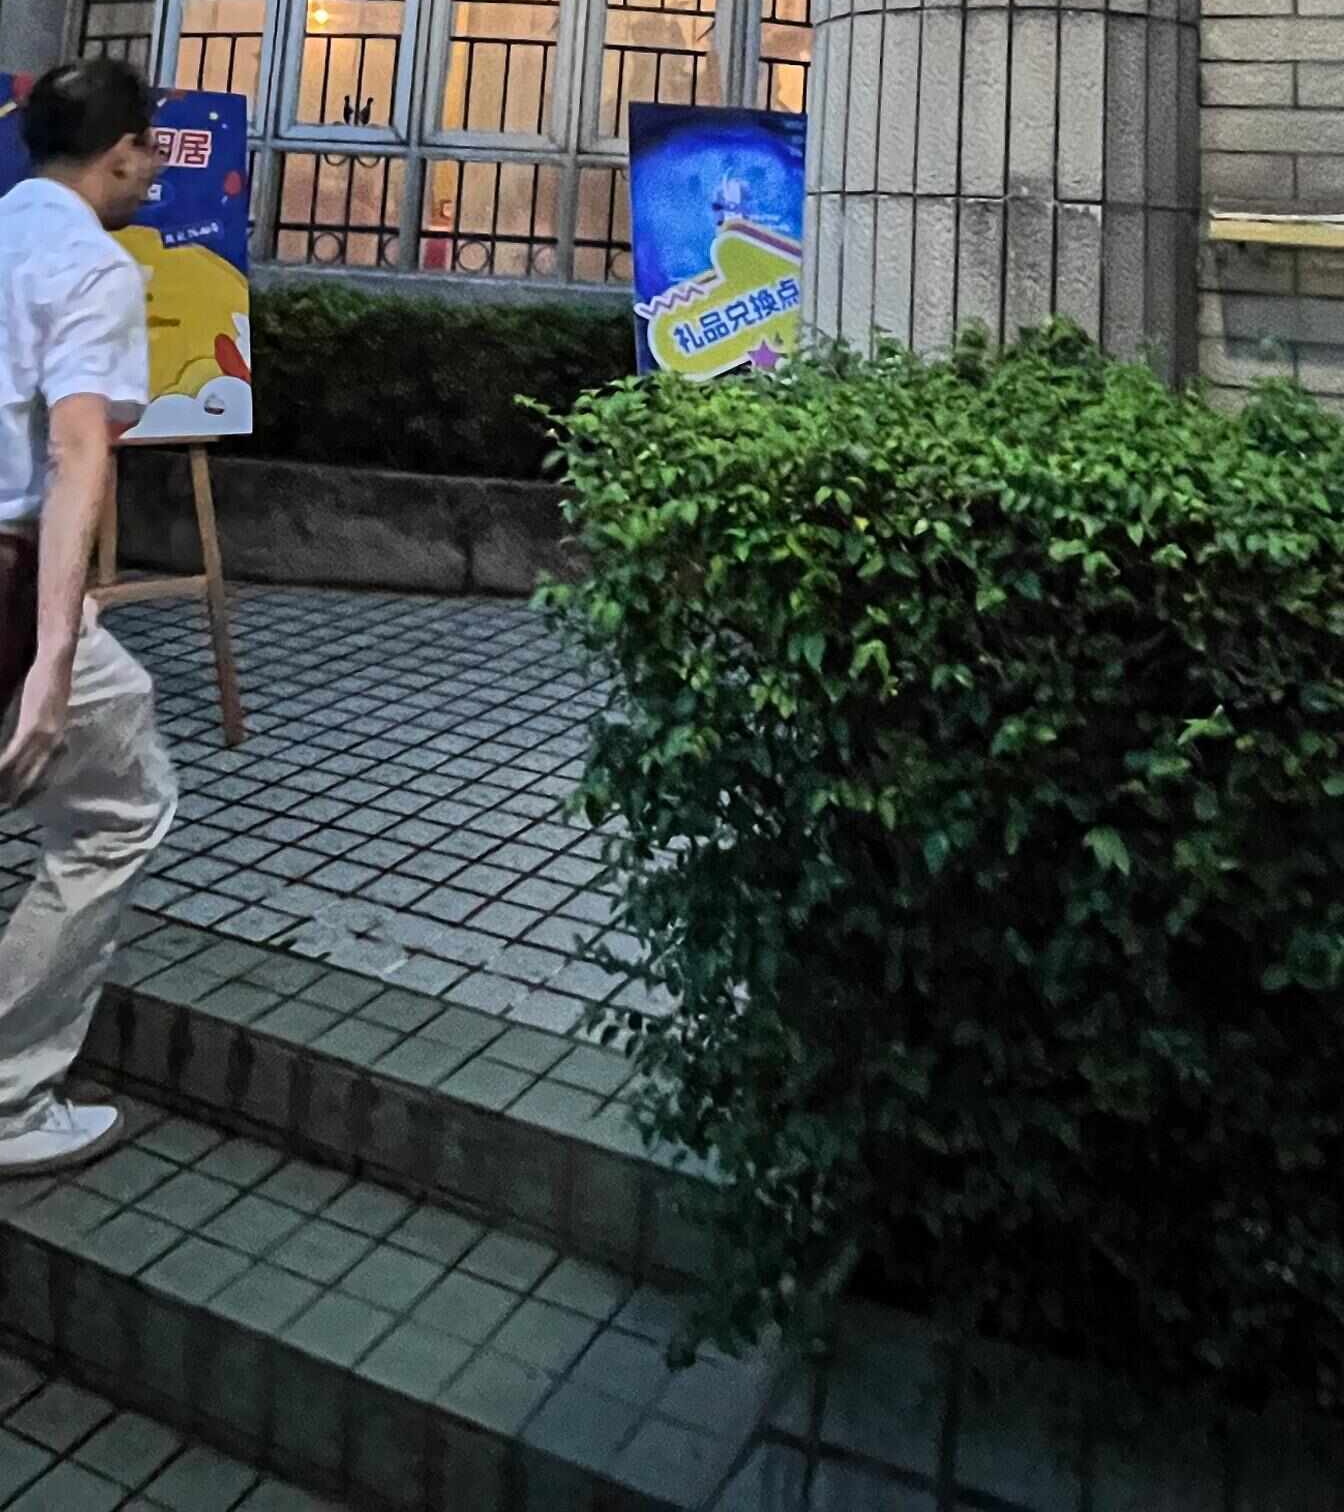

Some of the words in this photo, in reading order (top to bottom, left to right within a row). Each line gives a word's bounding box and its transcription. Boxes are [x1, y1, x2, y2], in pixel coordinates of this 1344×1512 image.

[673, 277, 800, 353] 礼品兑换点
